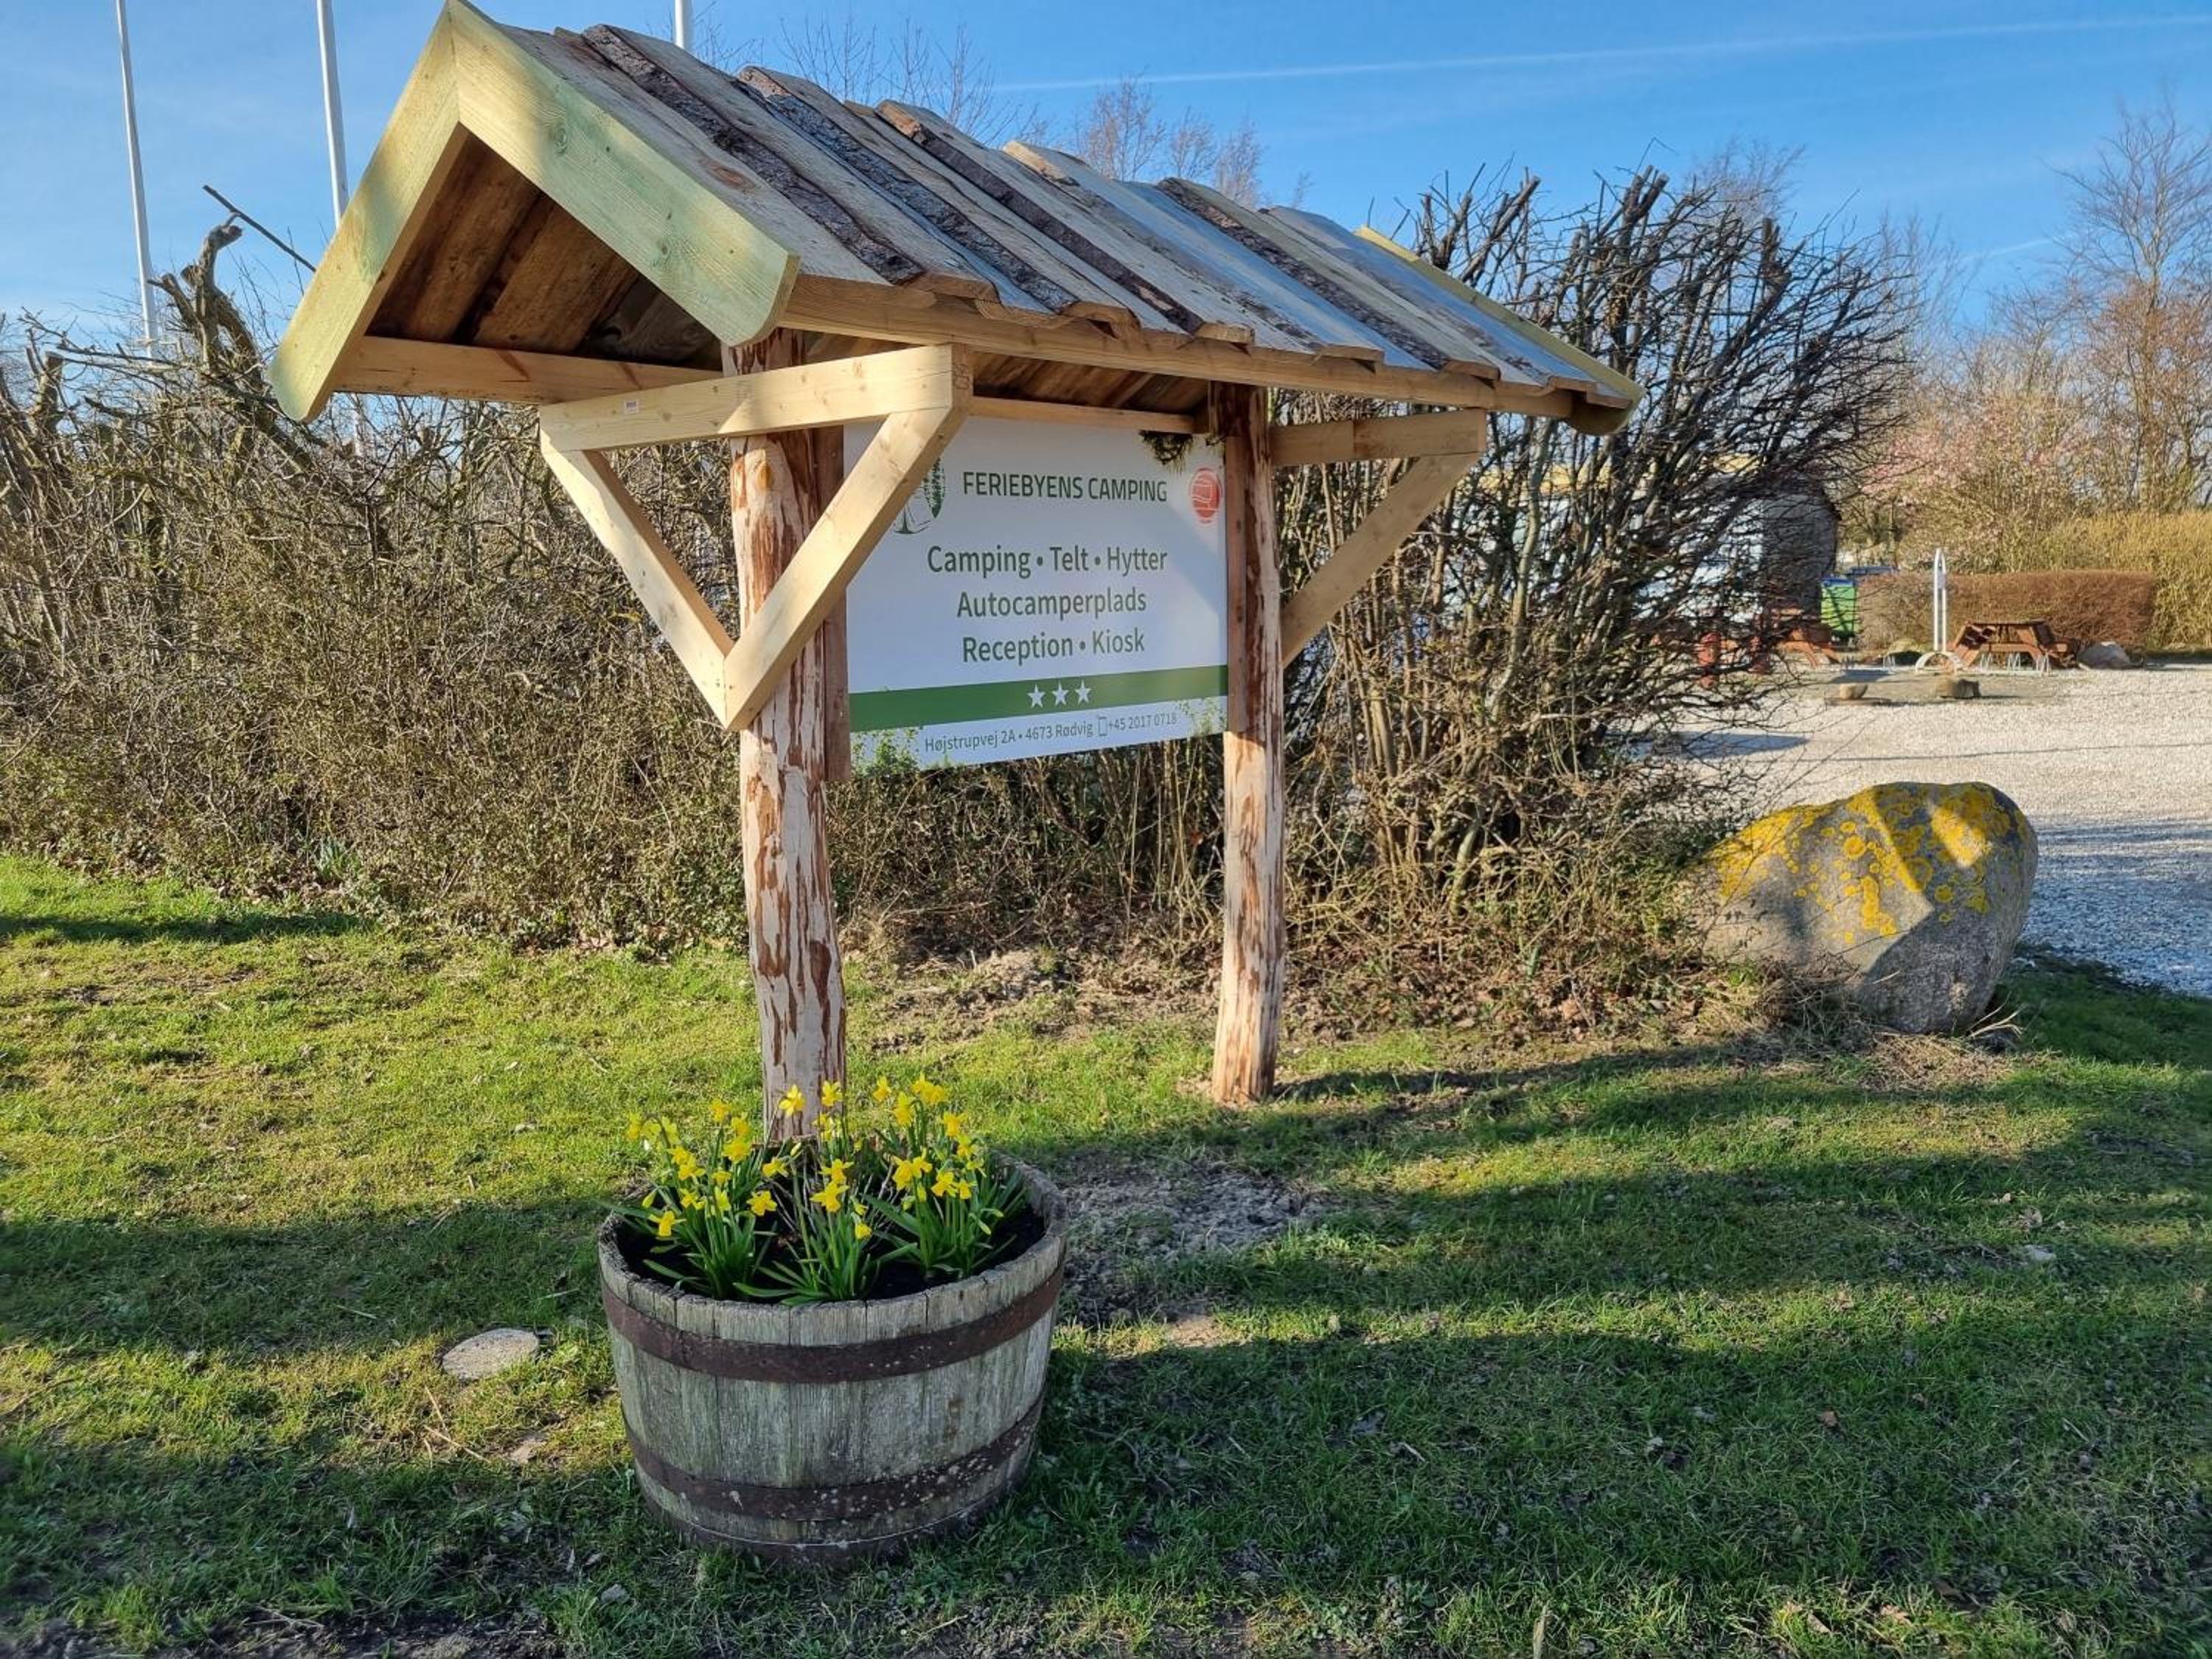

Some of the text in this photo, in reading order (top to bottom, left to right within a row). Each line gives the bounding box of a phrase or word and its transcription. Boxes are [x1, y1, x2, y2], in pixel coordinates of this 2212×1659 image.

[963, 471, 1168, 502] FERIEBYENS CAMPING
[927, 544, 1168, 579] Camping Telt Hytter
[957, 587, 1147, 621] Autocamperplads
[963, 627, 1145, 665] Reception Kiosk
[925, 731, 998, 753] Højstrupvej
[1001, 729, 1016, 744] 2A
[1026, 725, 1053, 740] 4673
[1055, 720, 1093, 737] Rødvig
[1128, 714, 1152, 729] 2017
